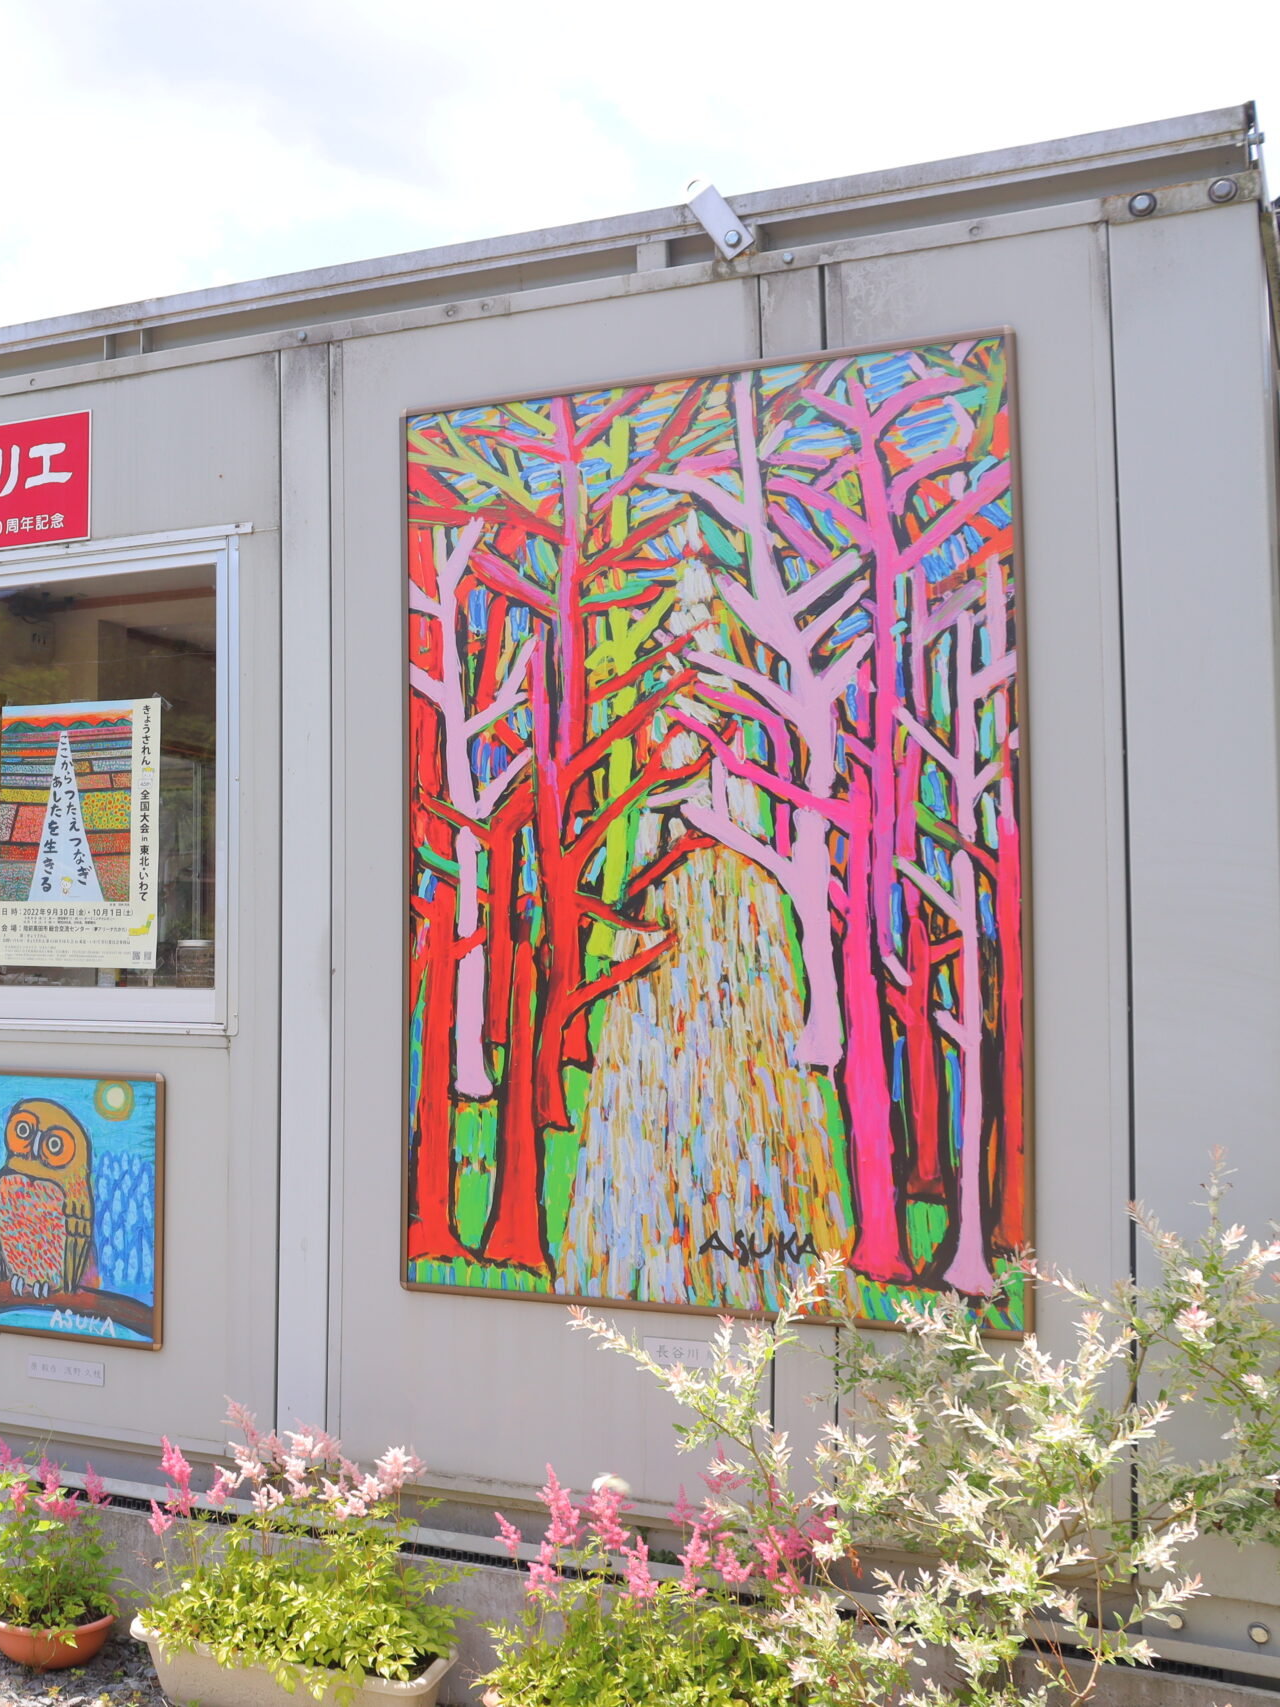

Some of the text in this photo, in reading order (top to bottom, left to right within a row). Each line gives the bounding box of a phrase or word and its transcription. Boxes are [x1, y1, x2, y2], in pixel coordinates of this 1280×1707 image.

[141, 704, 152, 766] きょうされん
[40, 776, 63, 893] あしたを生きる
[60, 735, 93, 886] ここから つたえ つなぎ
[698, 1228, 821, 1270] ASUKA
[49, 1308, 117, 1339] ASUKA
[655, 1344, 699, 1360] 長谷川
